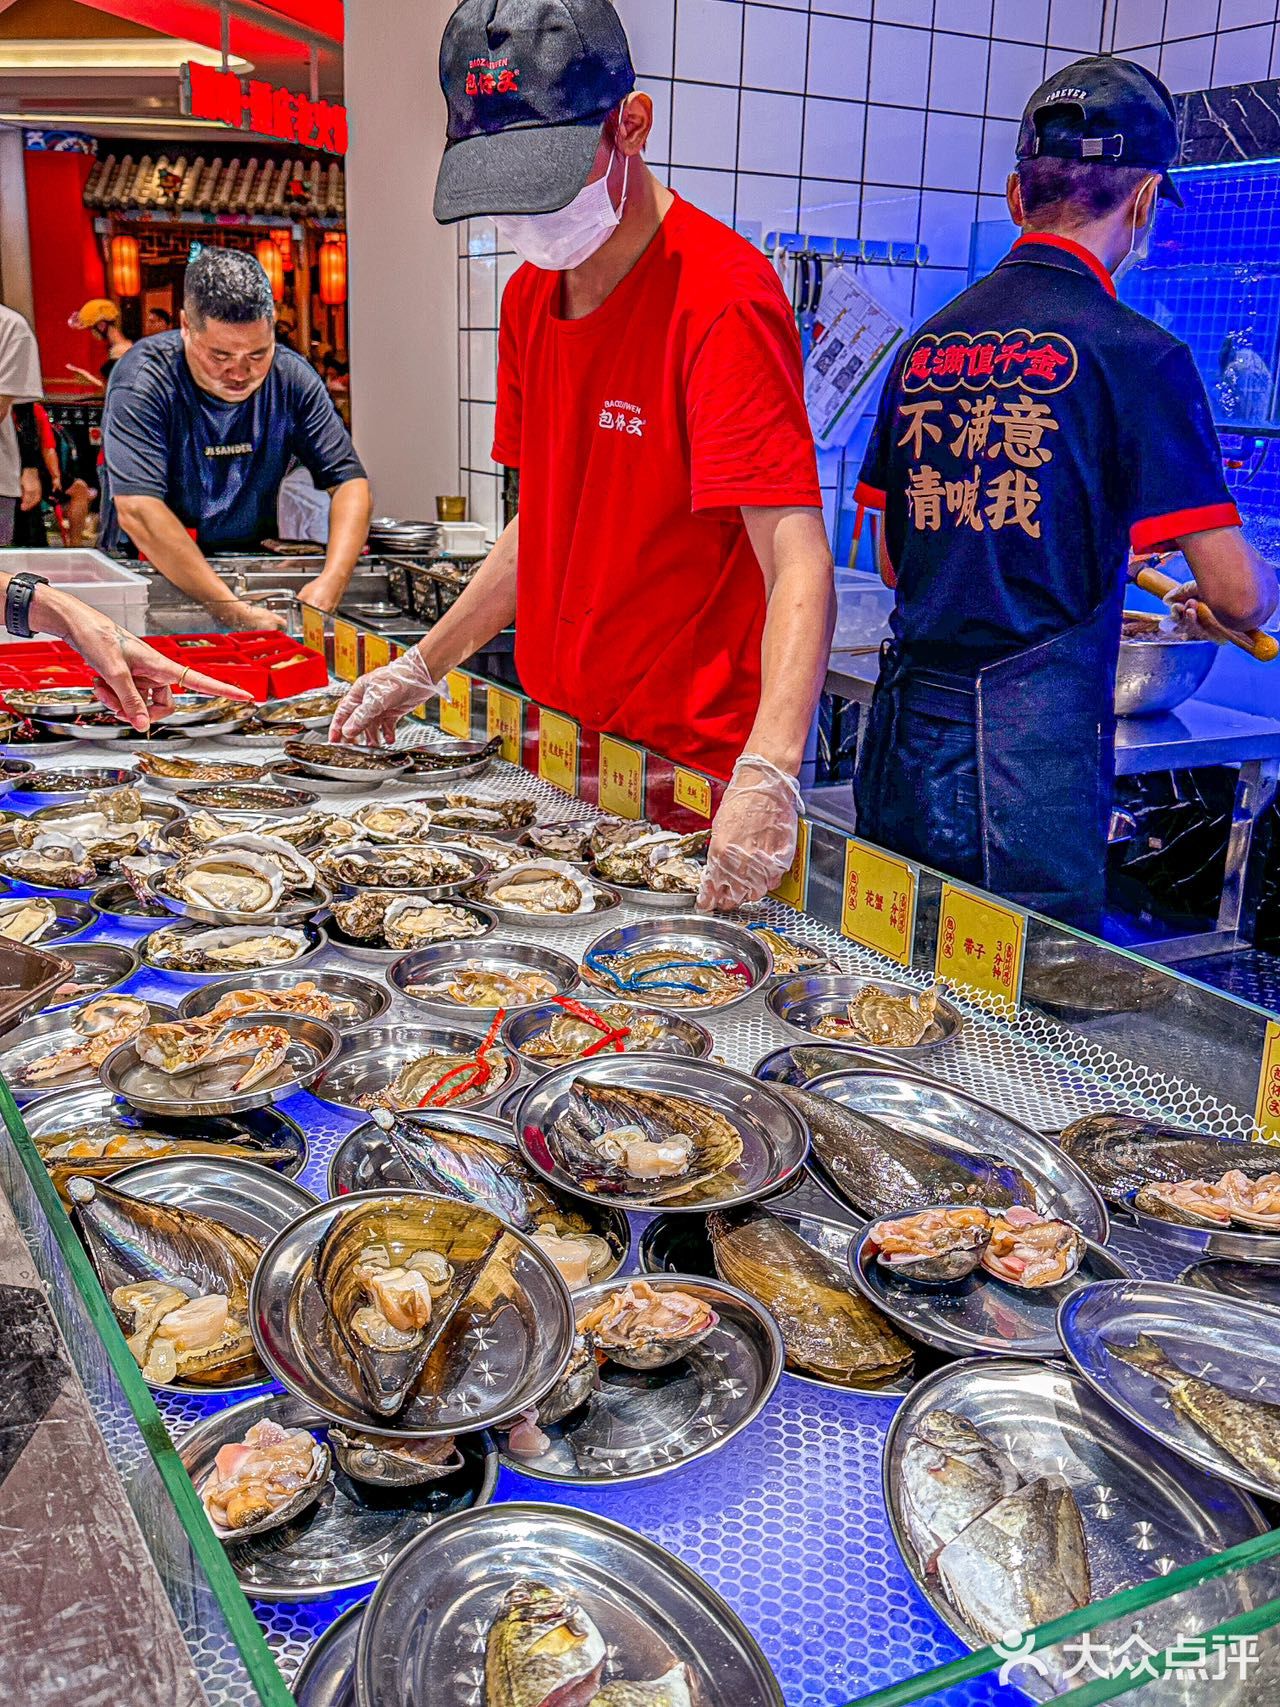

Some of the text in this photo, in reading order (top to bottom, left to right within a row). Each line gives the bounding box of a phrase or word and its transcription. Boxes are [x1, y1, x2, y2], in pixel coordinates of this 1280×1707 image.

[1045, 87, 1087, 103] FOREVER
[897, 395, 1059, 468] 不满意
[905, 465, 1041, 538] 请喊我
[864, 889, 884, 912] 花蟹
[963, 937, 986, 960] 带子
